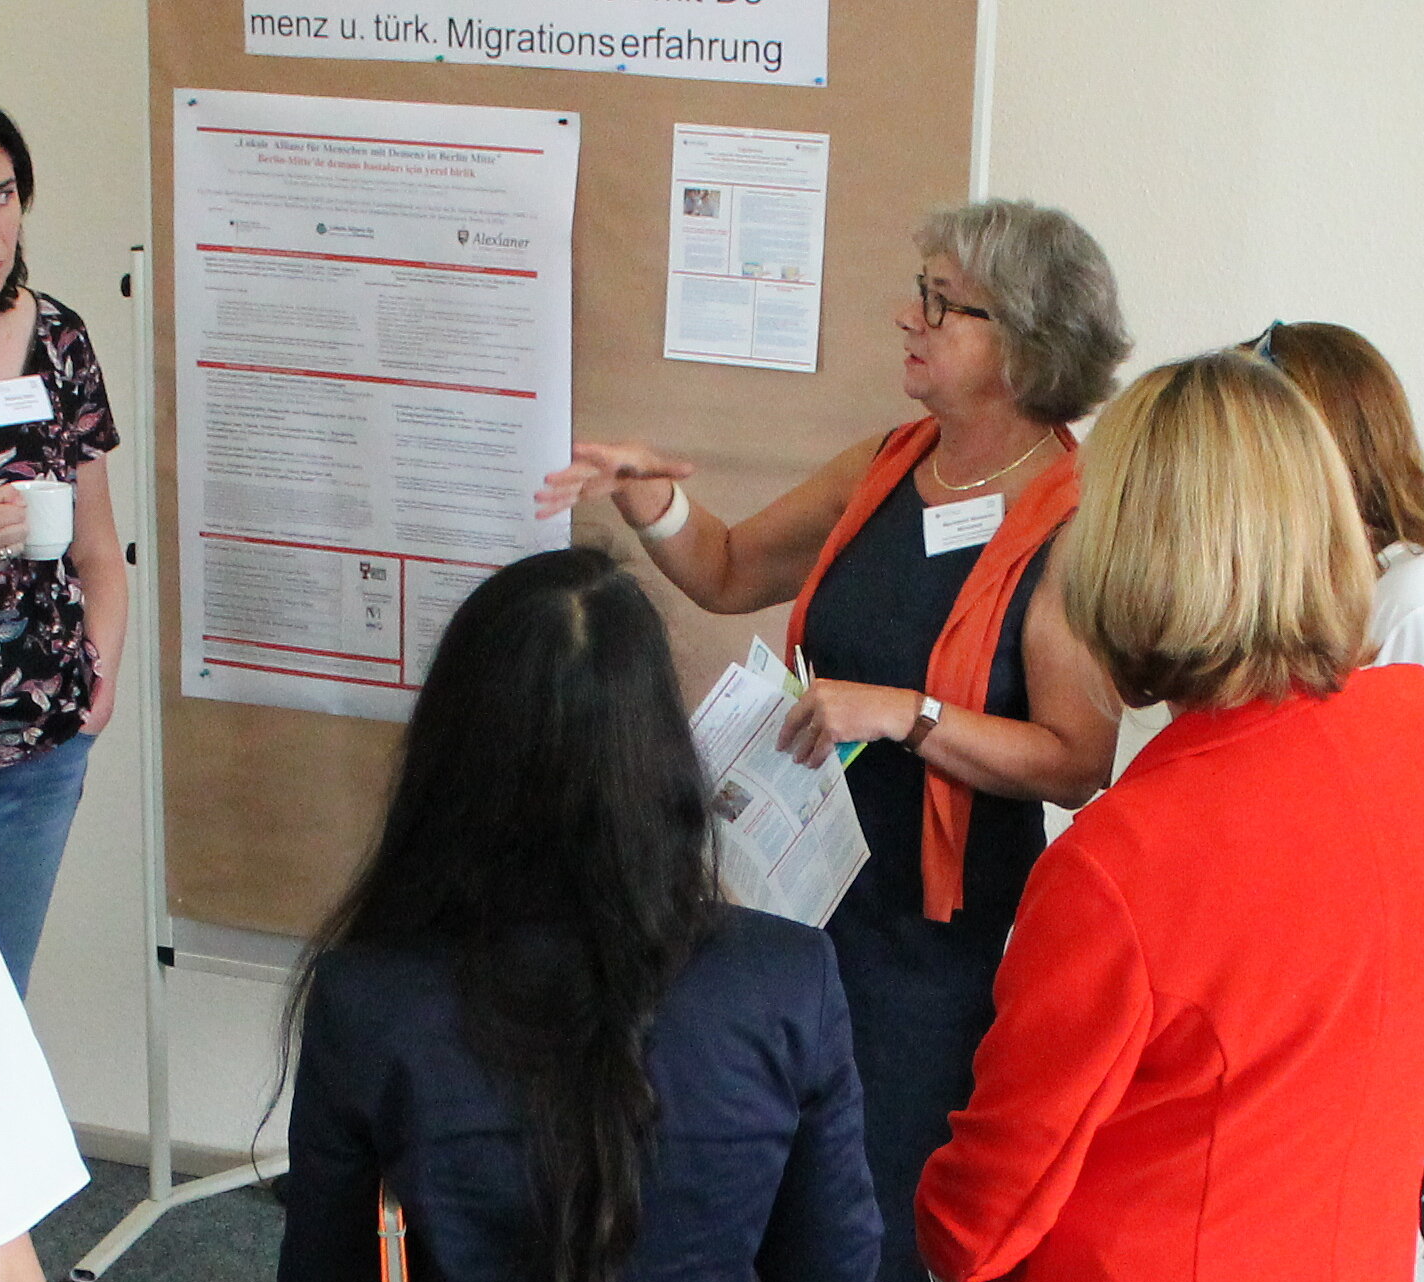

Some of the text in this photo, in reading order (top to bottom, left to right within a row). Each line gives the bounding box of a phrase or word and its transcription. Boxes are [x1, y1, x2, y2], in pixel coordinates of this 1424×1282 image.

[251, 13, 784, 73] menz u. türk. Migrationserfahrung
[473, 232, 531, 249] Alexianer
